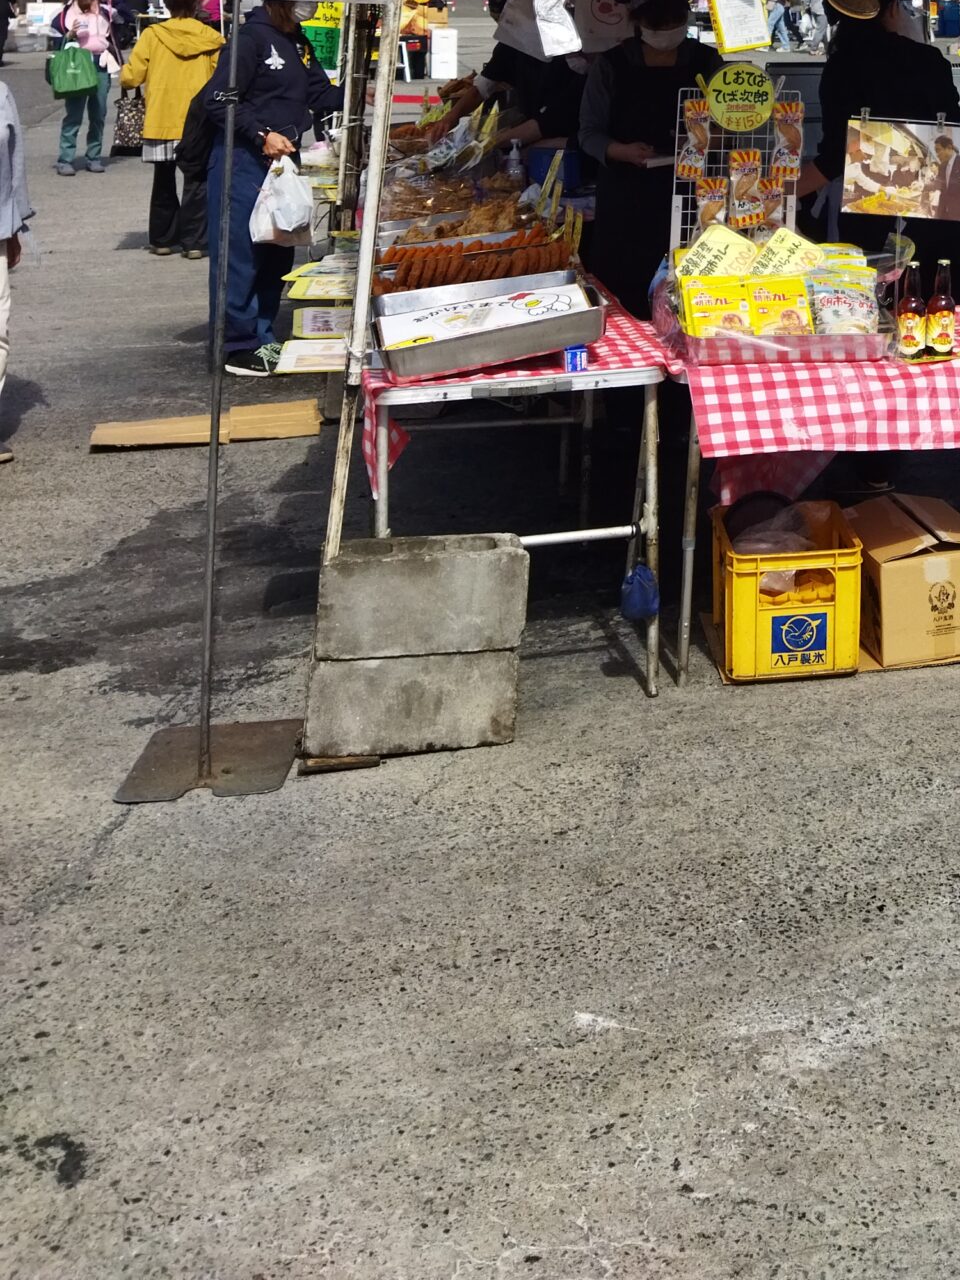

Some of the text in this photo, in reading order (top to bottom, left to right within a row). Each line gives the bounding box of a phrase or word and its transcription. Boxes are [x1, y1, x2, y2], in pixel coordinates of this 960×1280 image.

[712, 89, 769, 106] てば次郎
[774, 651, 825, 666] 八戸製氷
